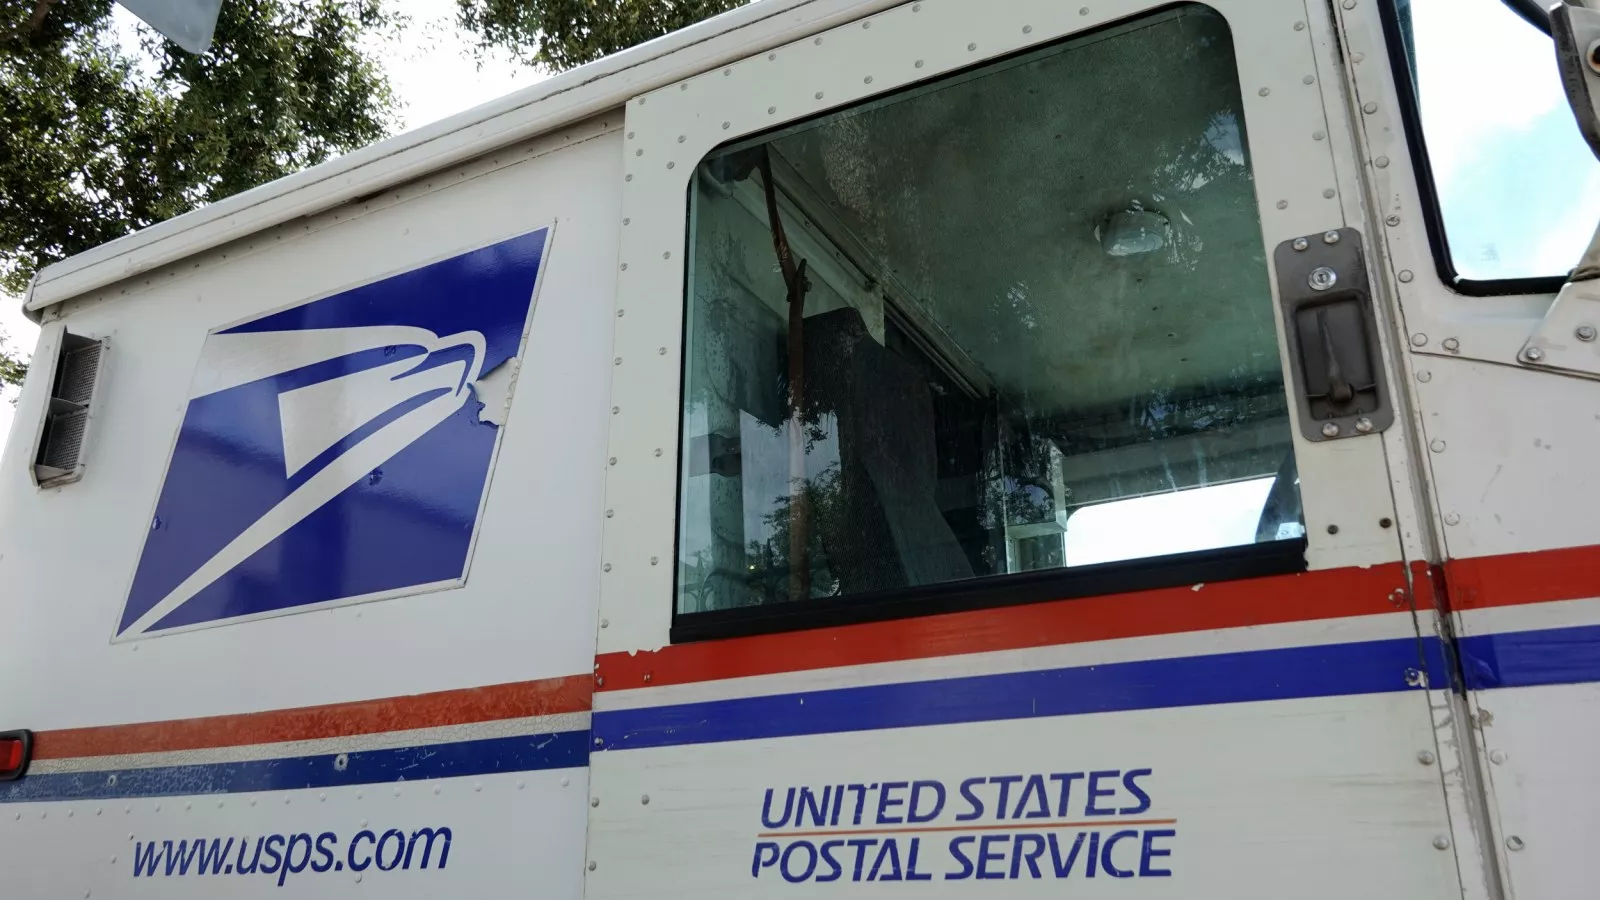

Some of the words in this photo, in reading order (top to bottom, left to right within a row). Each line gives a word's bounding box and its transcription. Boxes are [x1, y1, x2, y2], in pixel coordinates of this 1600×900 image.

[761, 780, 946, 829] UNITED
[955, 768, 1152, 821] STATES
[133, 826, 452, 886] www.usps.com
[752, 837, 933, 884] POSTAL
[944, 829, 1176, 880] SERVICE
